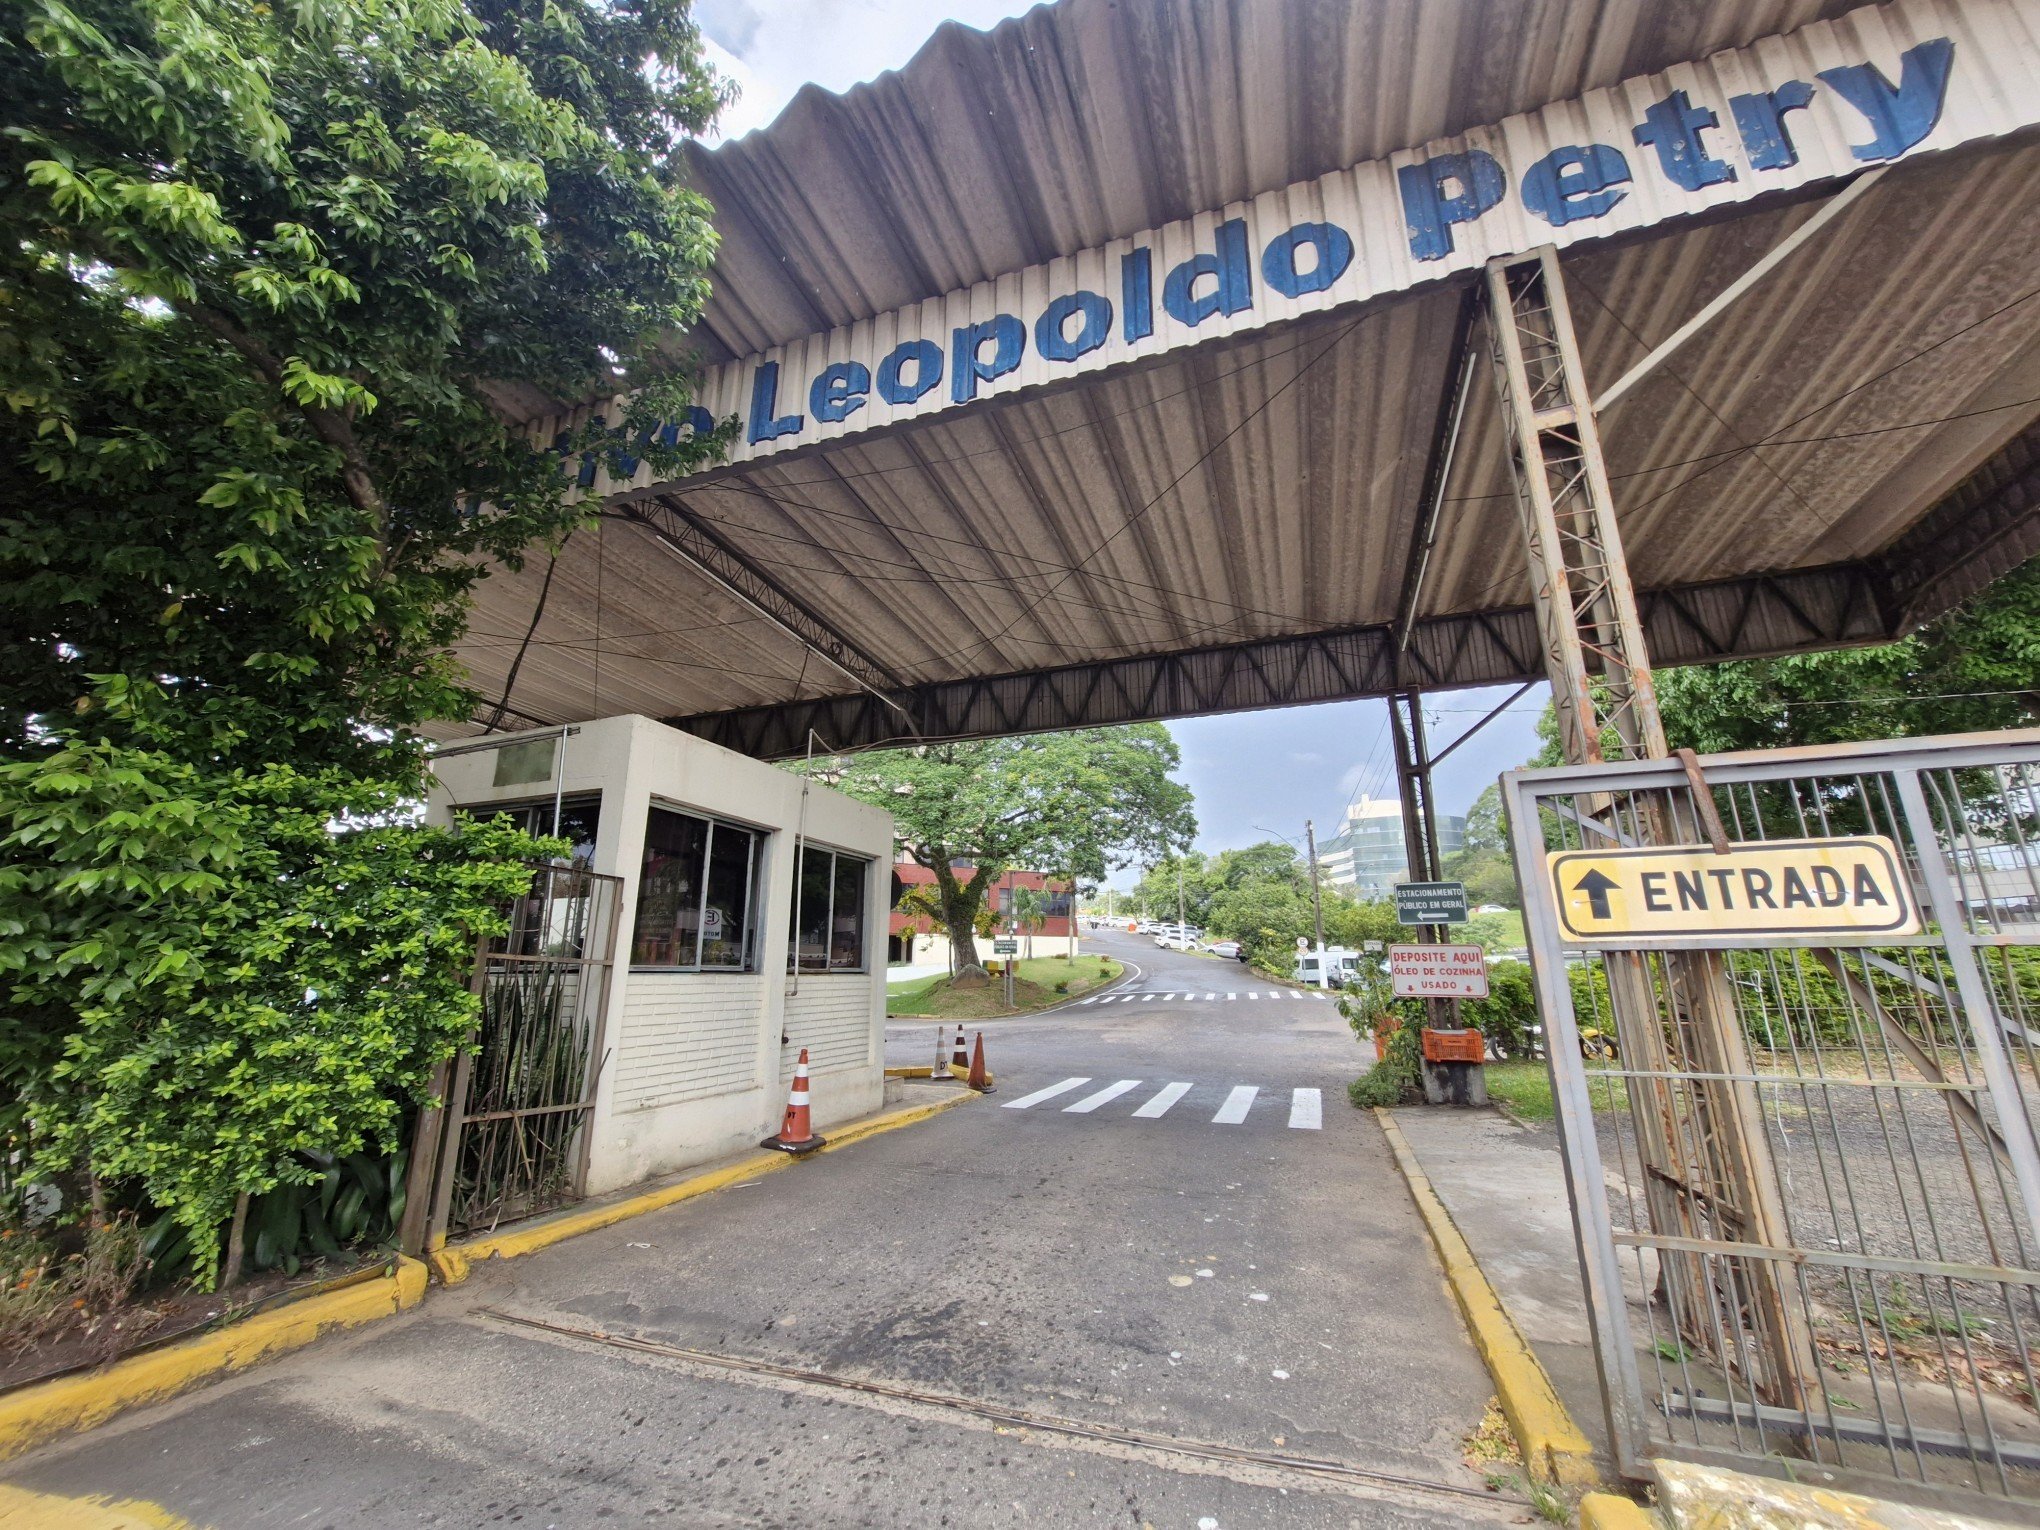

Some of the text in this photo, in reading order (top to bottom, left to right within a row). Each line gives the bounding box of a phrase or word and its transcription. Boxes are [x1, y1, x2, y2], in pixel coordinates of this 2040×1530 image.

[747, 217, 1354, 447] Leopoldo
[1398, 888, 1462, 898] ESTACIONAMENTO
[1640, 863, 1888, 912] ENTRADA
[1430, 901, 1441, 909] EM
[1442, 900, 1464, 909] GERAL
[1393, 952, 1481, 964] DEPOSITE AQUI
[1394, 964, 1483, 976] ÓLEO DE COZINHA
[1421, 981, 1457, 989] USADO
